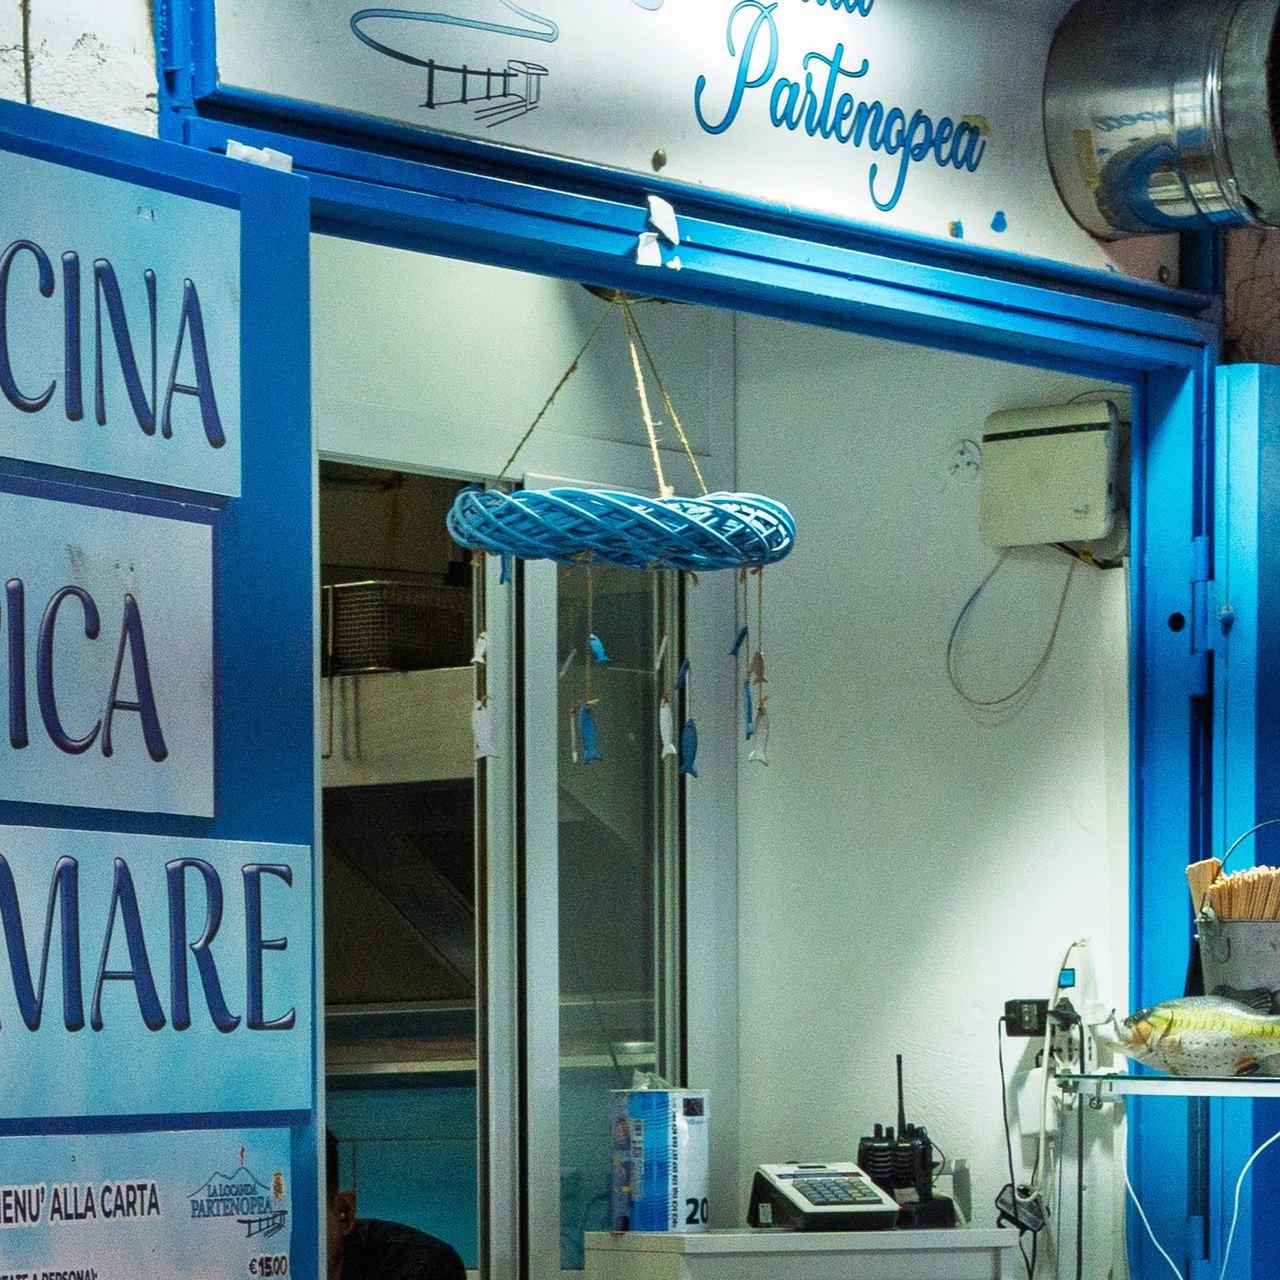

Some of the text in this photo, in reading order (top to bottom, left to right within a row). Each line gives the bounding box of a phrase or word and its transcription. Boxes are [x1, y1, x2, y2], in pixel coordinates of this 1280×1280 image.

[694, 0, 986, 211] Partenopea
[50, 1186, 97, 1222] ALLA
[101, 1183, 161, 1219] CARTA
[190, 1197, 271, 1219] PARTENOPEA
